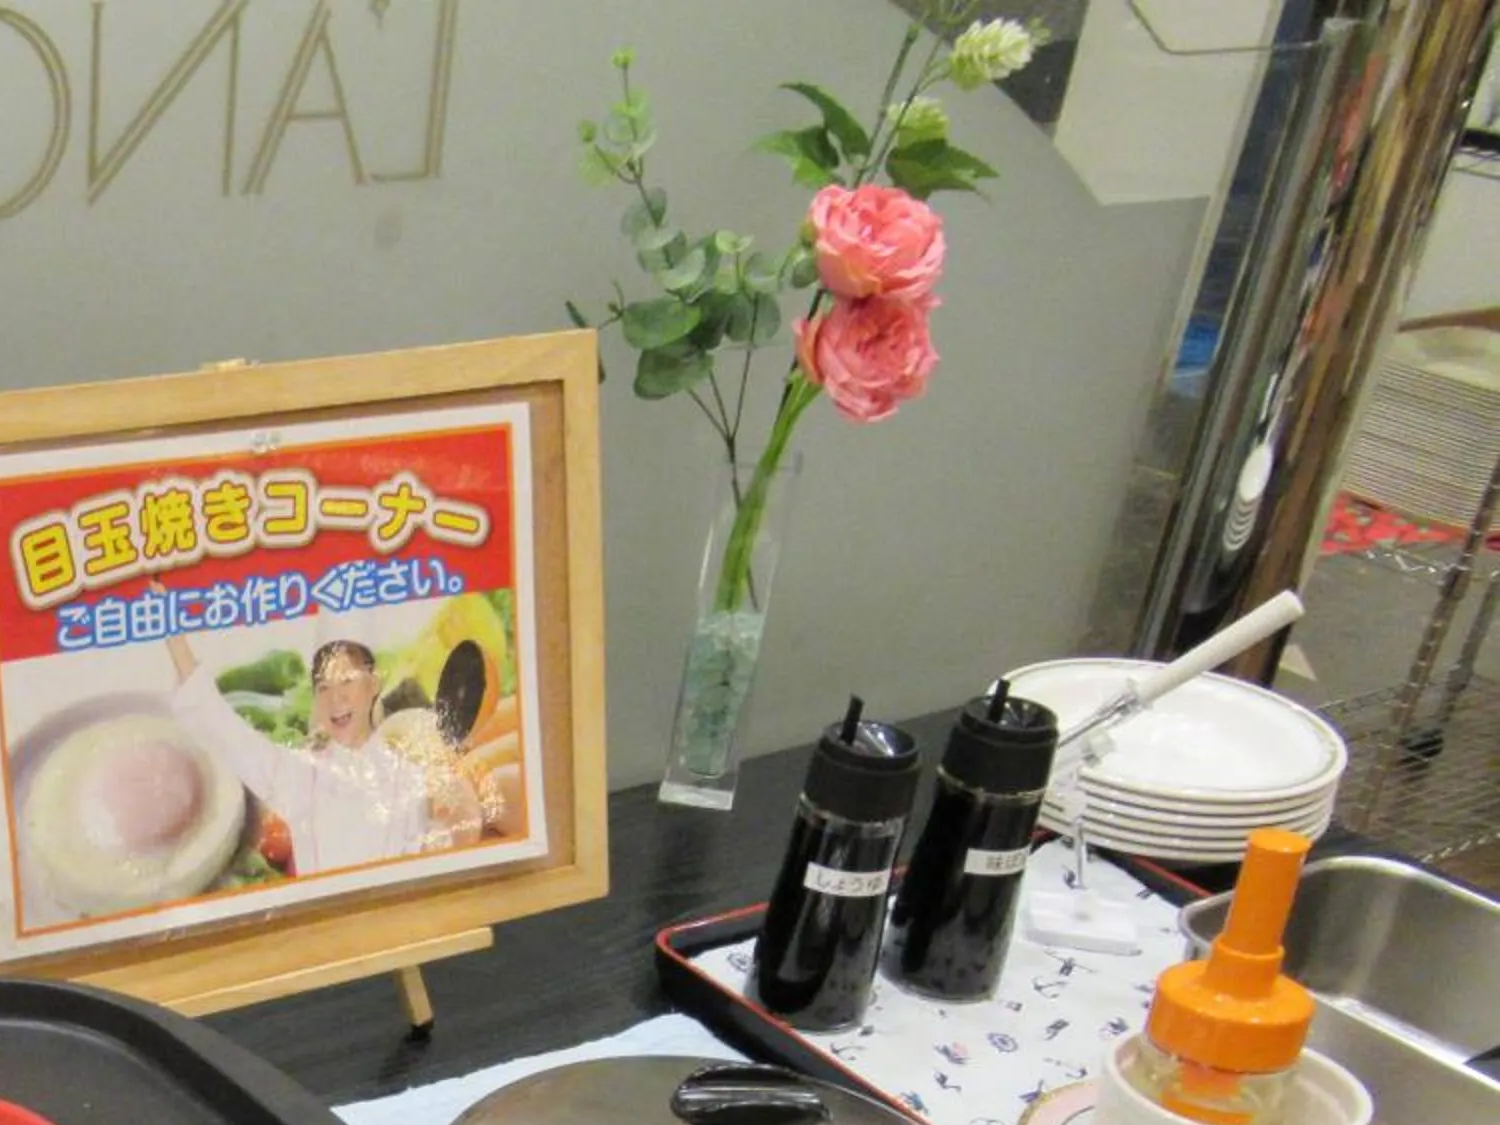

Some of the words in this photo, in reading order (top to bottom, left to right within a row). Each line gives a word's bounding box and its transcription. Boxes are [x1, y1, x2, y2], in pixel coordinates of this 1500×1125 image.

[18, 480, 483, 597] 目玉焼きコーナー
[56, 558, 465, 650] ご自由にお作りください。
